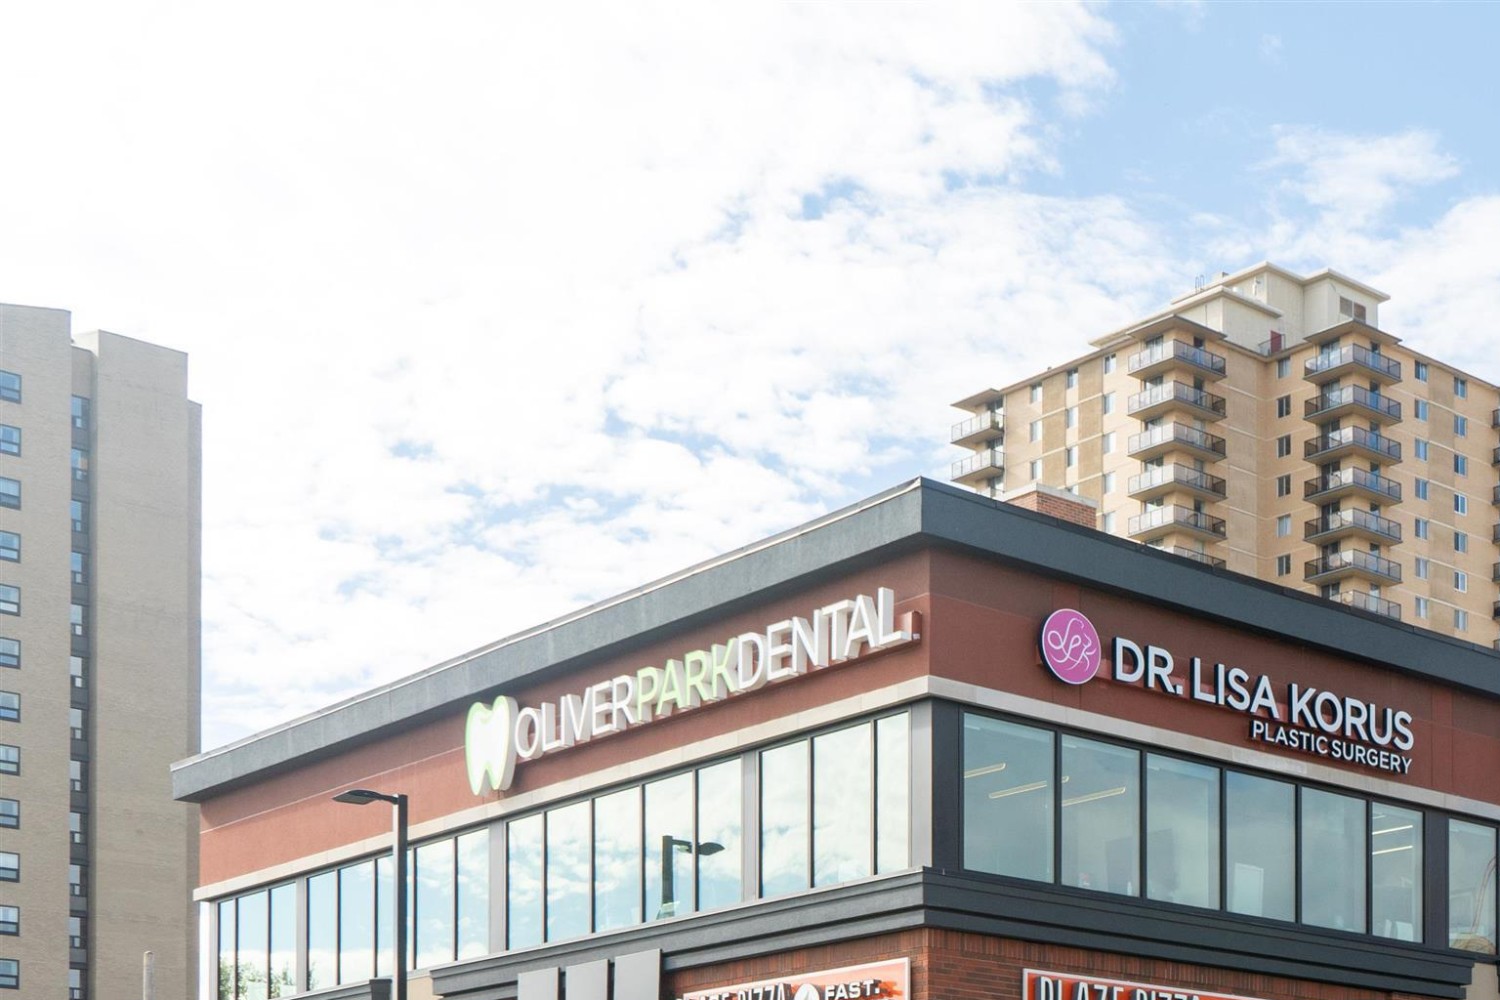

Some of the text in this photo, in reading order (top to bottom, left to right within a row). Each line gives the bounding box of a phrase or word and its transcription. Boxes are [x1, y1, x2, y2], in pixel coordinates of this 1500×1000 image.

[1114, 637, 1184, 695] DR.
[1192, 657, 1280, 719] LISA
[1289, 685, 1414, 751] KORUS
[1251, 720, 1413, 774] PLASTIC SURGERY
